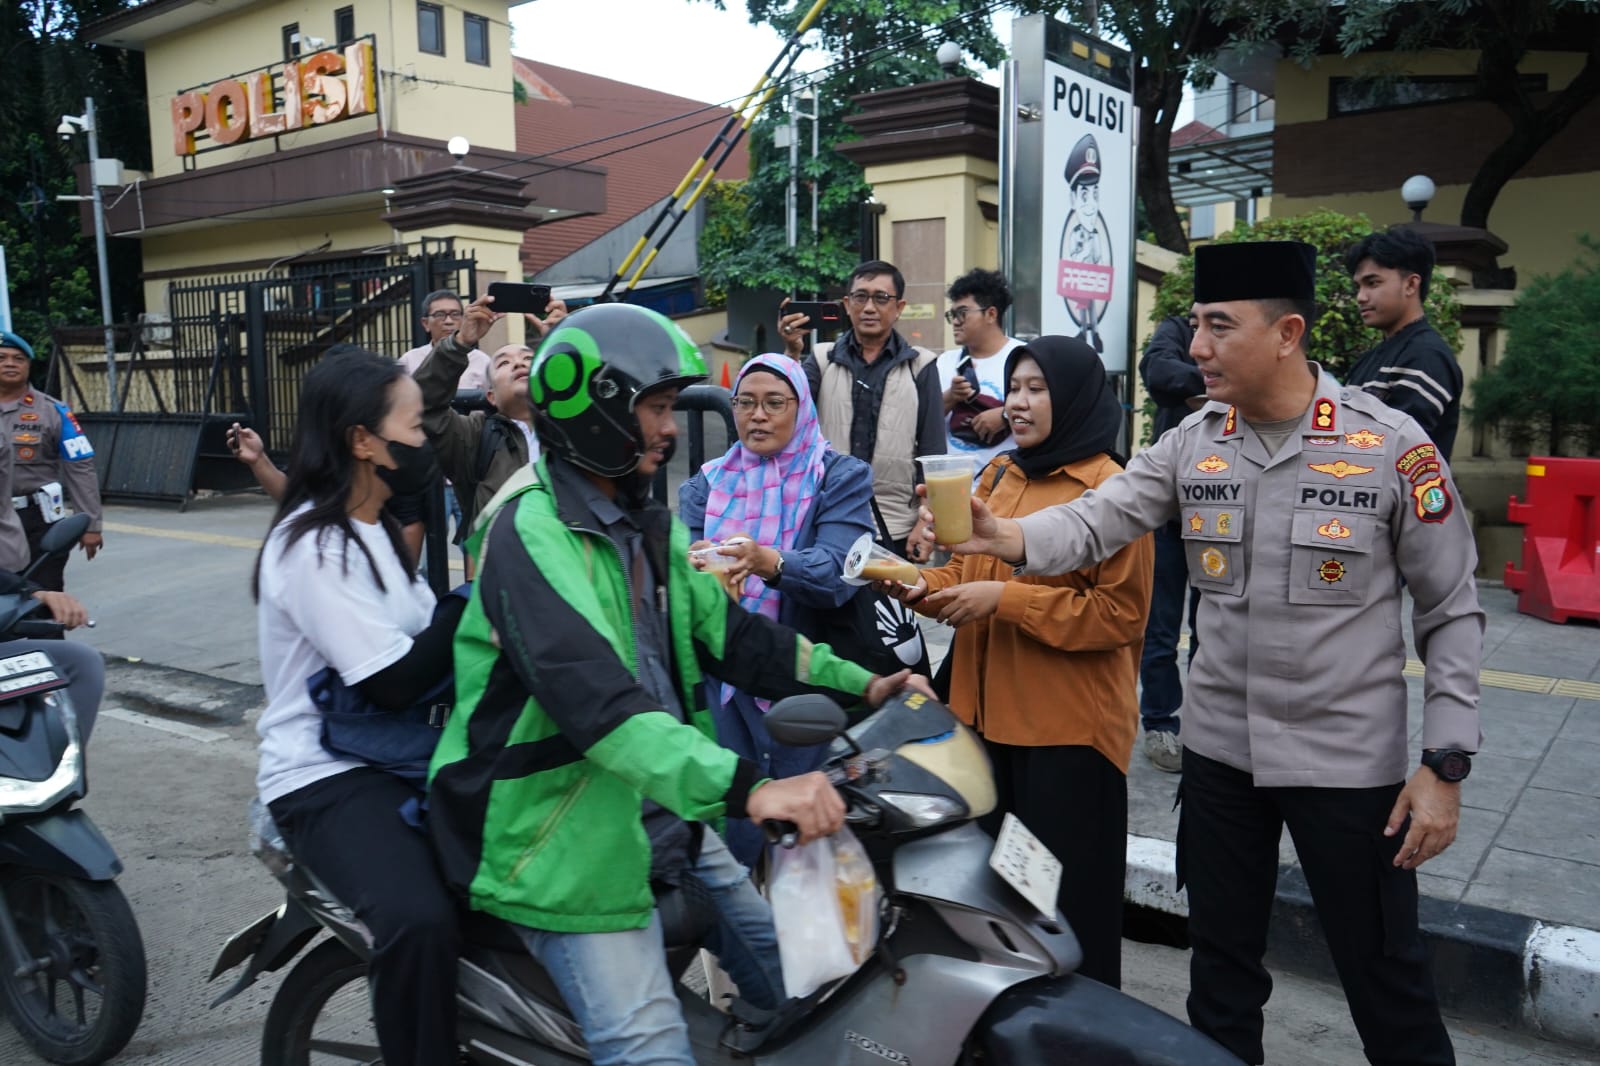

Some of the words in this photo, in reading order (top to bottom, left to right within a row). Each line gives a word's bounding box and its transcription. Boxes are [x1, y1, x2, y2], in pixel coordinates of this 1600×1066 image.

[171, 42, 374, 156] POLISI
[1053, 75, 1124, 133] POLISI
[1182, 484, 1241, 501] YONKY
[1301, 487, 1377, 509] POLRI
